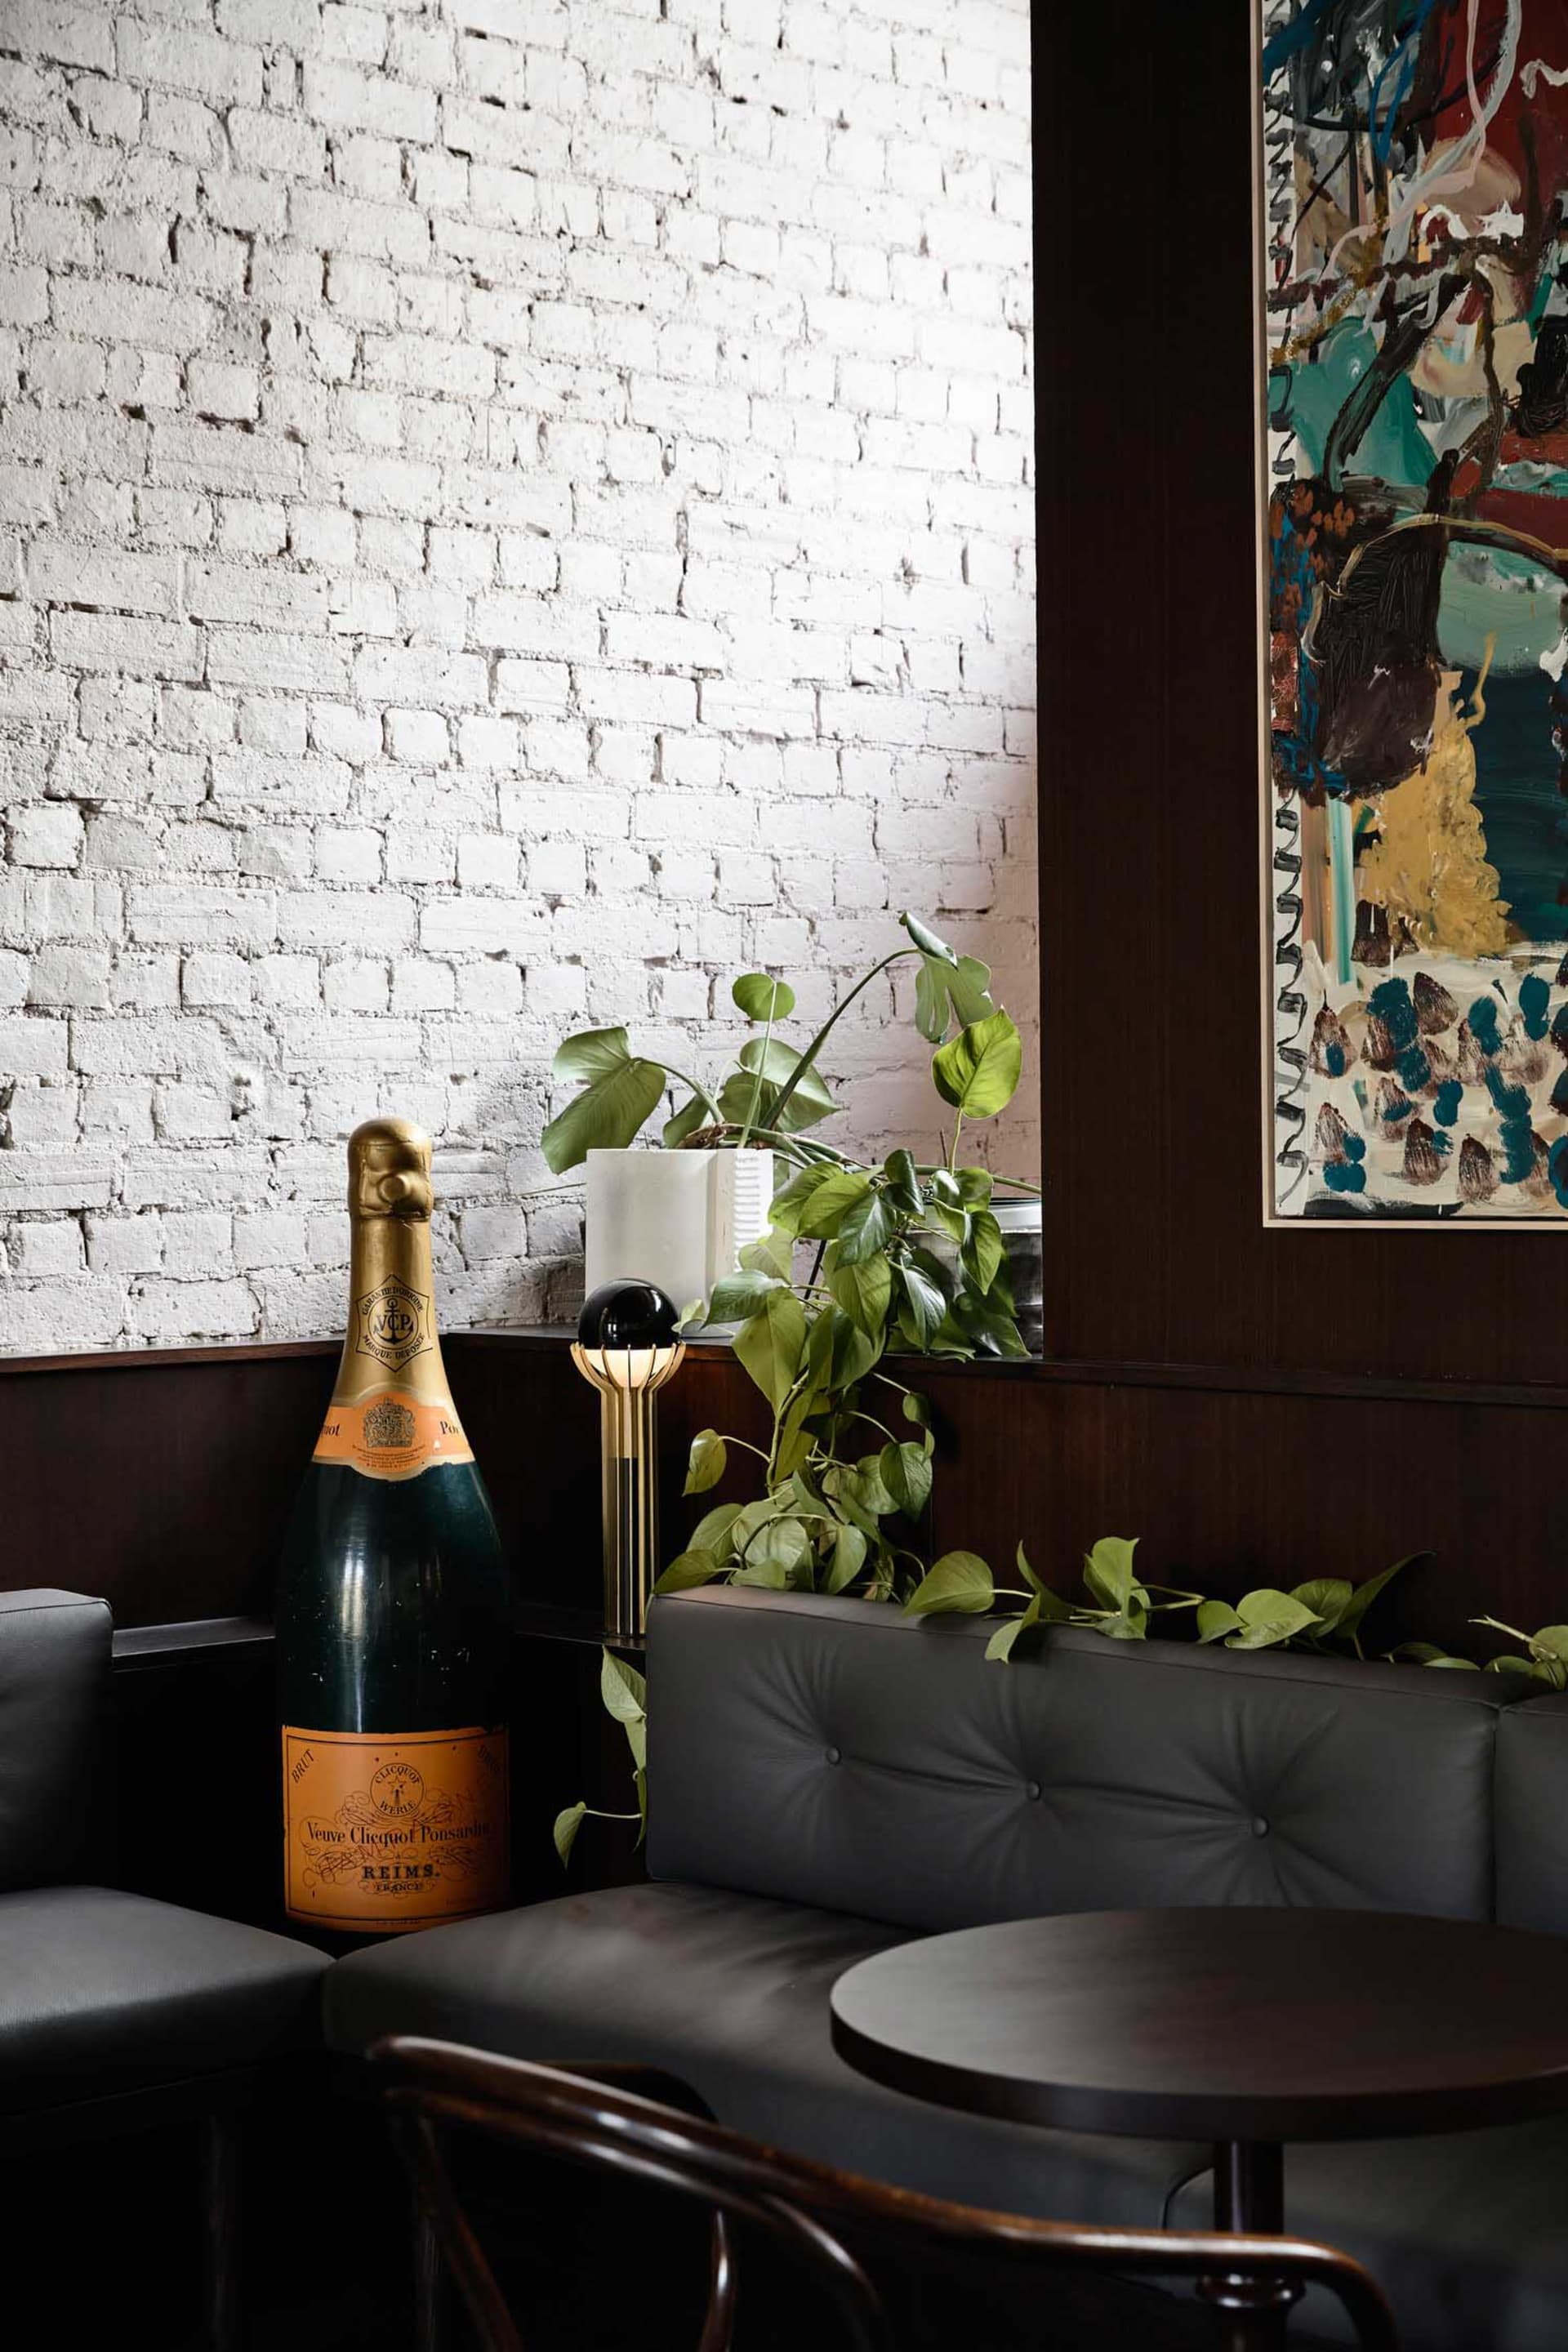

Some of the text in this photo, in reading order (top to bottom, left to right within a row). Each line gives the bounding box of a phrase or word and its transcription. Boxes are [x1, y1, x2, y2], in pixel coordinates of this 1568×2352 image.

[376, 1314, 411, 1330] VCP
[363, 1334, 392, 1359] MARQUE
[292, 1748, 314, 1784] BRUT
[375, 1766, 421, 1784] CLICQUOT
[307, 1821, 345, 1842] Veuve
[350, 1826, 413, 1847] Clicquot
